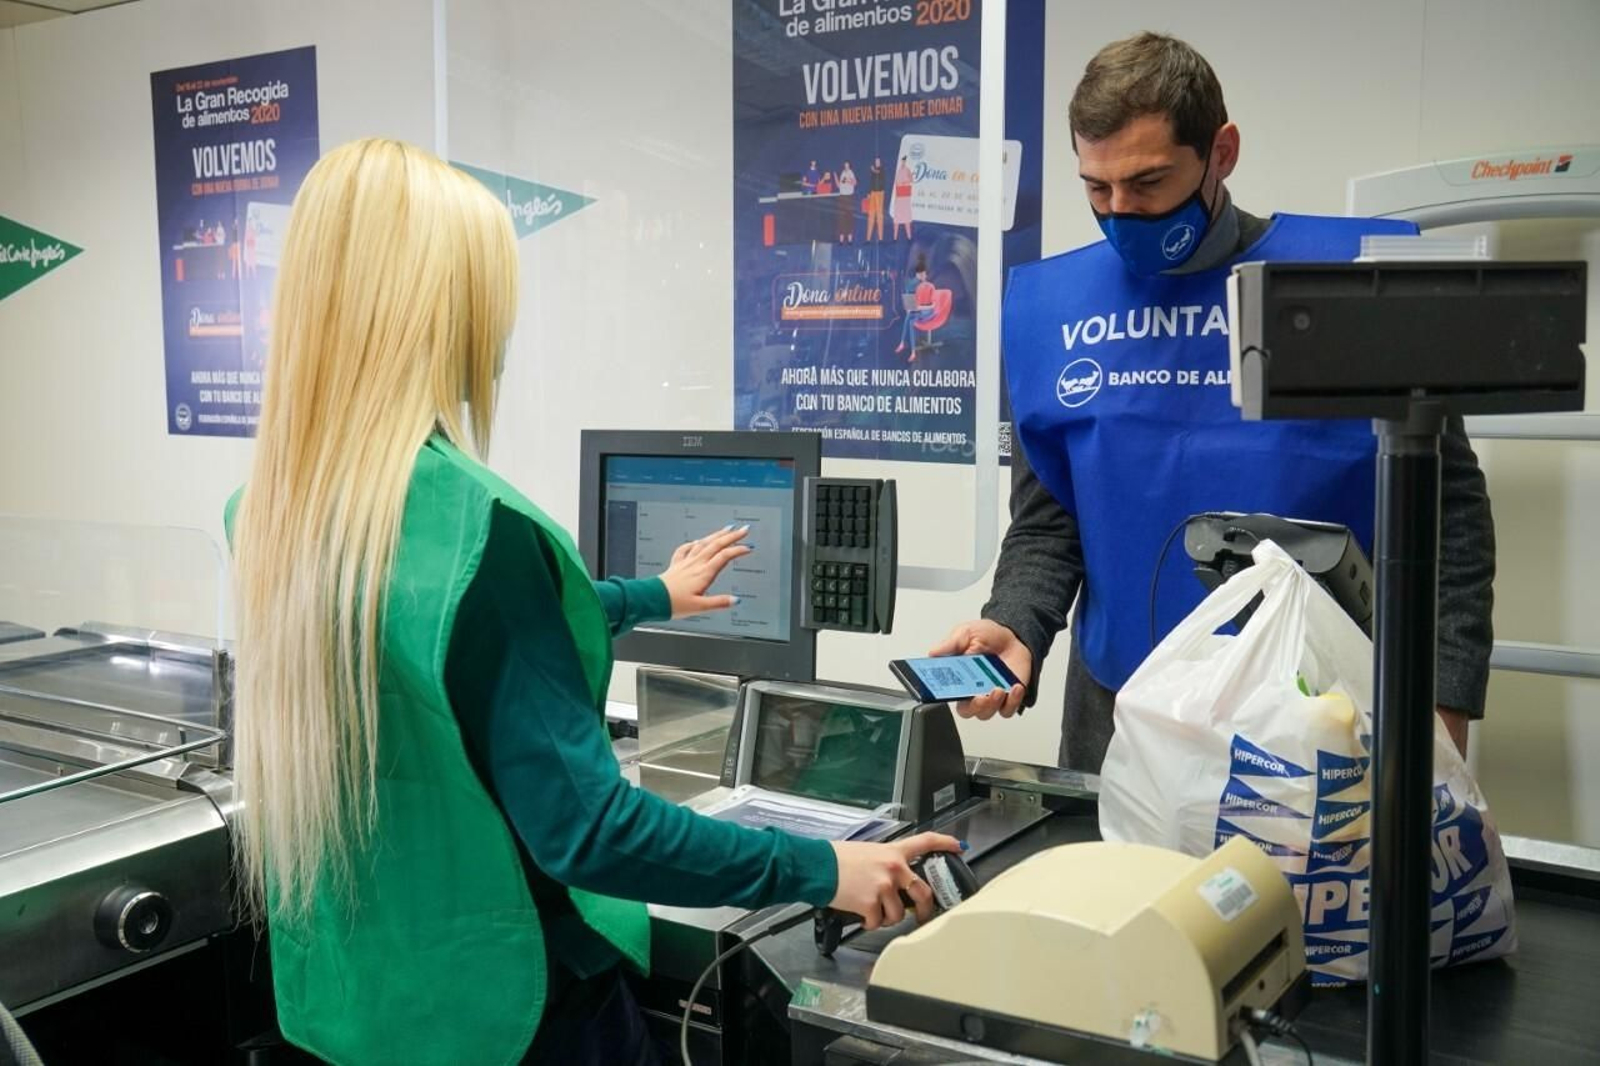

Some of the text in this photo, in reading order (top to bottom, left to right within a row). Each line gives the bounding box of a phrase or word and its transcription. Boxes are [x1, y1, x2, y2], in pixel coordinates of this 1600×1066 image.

[786, 17, 810, 37] de
[815, 5, 912, 33] alimentos
[916, 0, 971, 26] 2020
[802, 45, 959, 105] VOLVEMOS
[177, 95, 193, 113] La
[195, 91, 225, 110] Gran
[227, 80, 289, 107] Recogida
[182, 103, 280, 128] de alimentos 2020
[799, 96, 963, 128] CON UNA NUEVA FORMA DE DONAR
[192, 138, 277, 178] VOLVEMOS
[1471, 157, 1552, 180] Checkpoint
[783, 281, 881, 311] Dona online
[1061, 305, 1230, 351] VOLUNTA
[781, 365, 976, 389] AHORA MÁS QUE NUNCA COLABORA
[1108, 370, 1232, 386] BANCO DE ALI
[796, 393, 962, 416] CON TU BANCO DE ALIMENTOS
[684, 436, 703, 447] IBM
[834, 428, 870, 441] ESPAÑOLA
[871, 430, 881, 441] DE
[882, 430, 911, 443] BANCOS
[912, 431, 924, 443] DE
[925, 432, 967, 445] ALIMENTOS
[1234, 749, 1285, 775] HIPERCOR
[1322, 767, 1363, 780] HIPERCO
[1225, 792, 1278, 814] HIPERCOR
[1318, 805, 1362, 825] HIPERCOR
